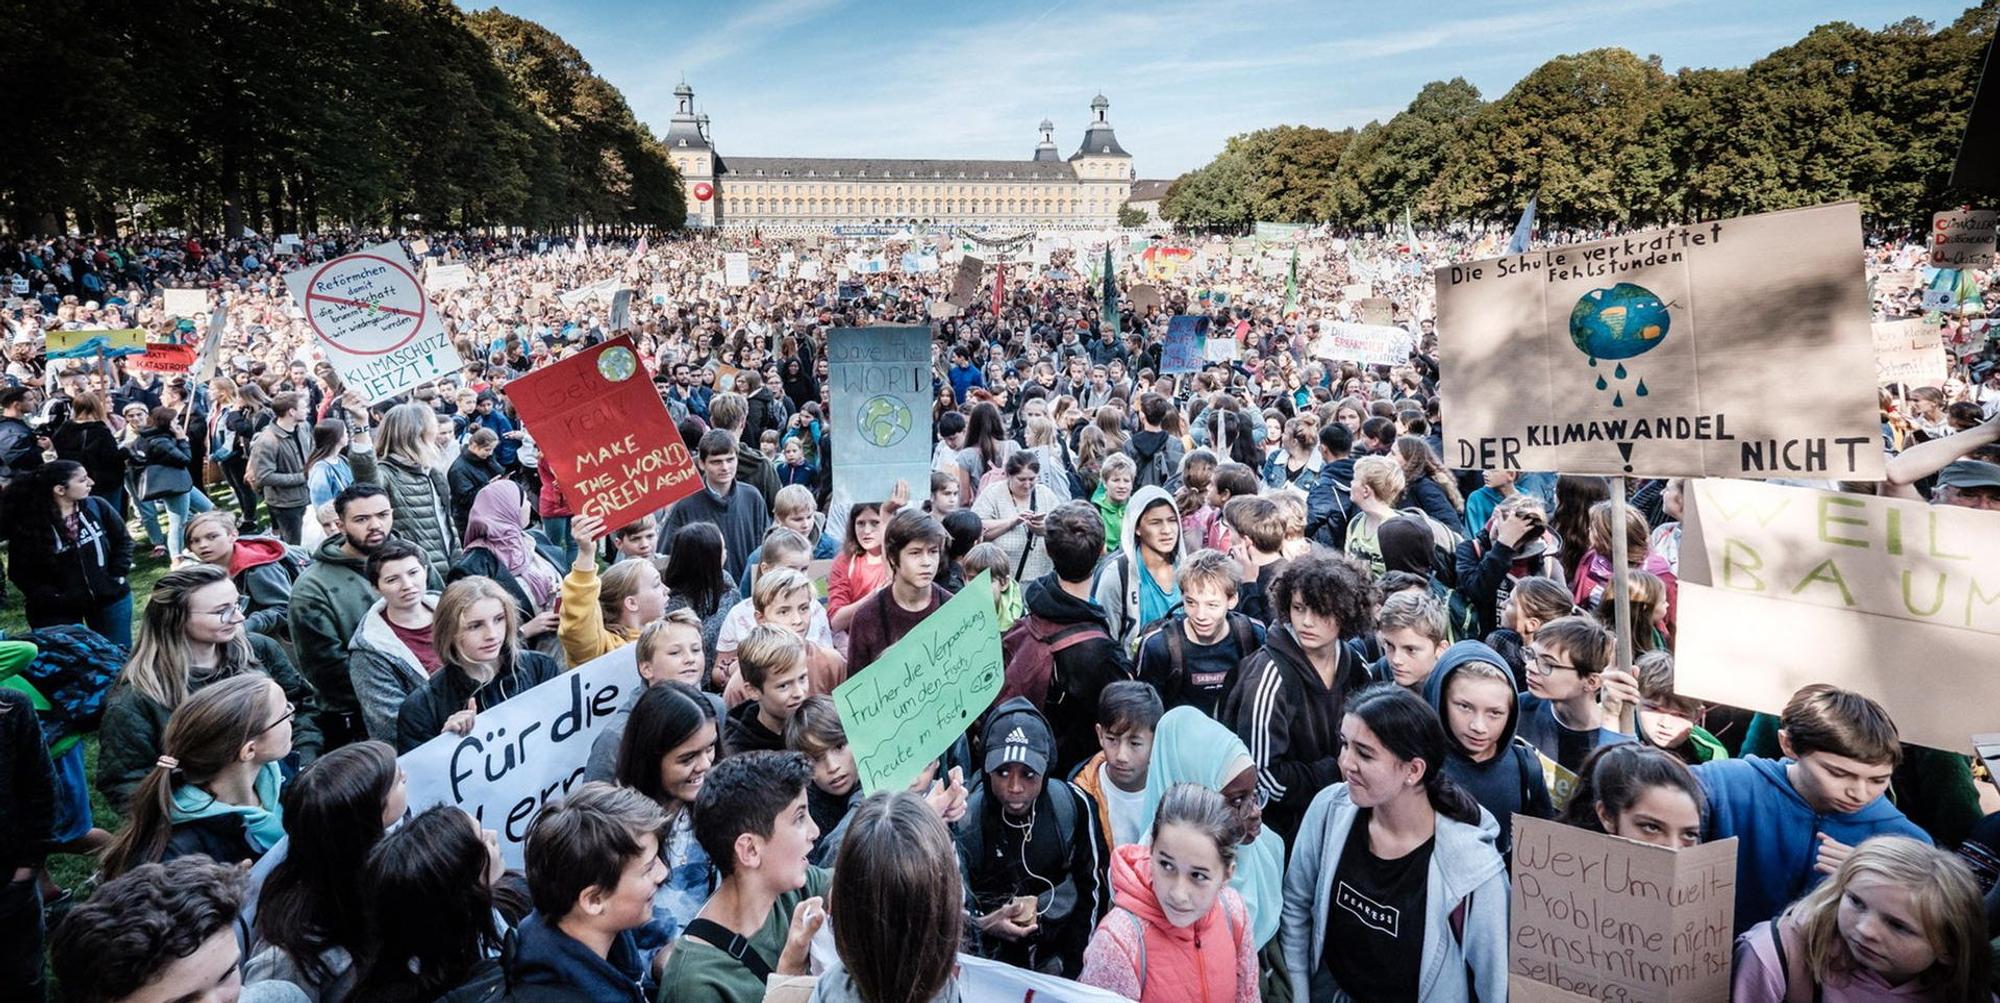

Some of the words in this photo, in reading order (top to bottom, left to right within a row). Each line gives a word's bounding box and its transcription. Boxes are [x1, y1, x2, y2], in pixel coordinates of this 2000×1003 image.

[1451, 265, 1482, 285] Die
[1498, 250, 1566, 279] Schule
[1583, 222, 1722, 261] verkraftet
[1549, 251, 1684, 283] Fehlstunden
[347, 280, 374, 296] damit
[344, 333, 449, 386] KLIMASCHUTZ
[835, 336, 880, 360] Save
[534, 364, 598, 408] Get
[842, 365, 930, 393] WORLD
[574, 472, 615, 496] THE
[622, 442, 689, 479] WORLD
[576, 433, 641, 473] MAKE
[1458, 436, 1521, 469] DER
[1527, 413, 1735, 447] KLIMAWANDEL
[1741, 436, 1870, 473] NICHT
[581, 475, 649, 518] GREEN
[1705, 490, 1971, 562] WEIL
[903, 661, 925, 689] die
[922, 610, 986, 668] Verpackung
[450, 721, 541, 804] für
[550, 673, 619, 743] die
[1516, 827, 1600, 883] Wer
[1518, 872, 1663, 951] Probleme
[1673, 909, 1728, 956] nicht
[1518, 957, 1599, 997] selber
